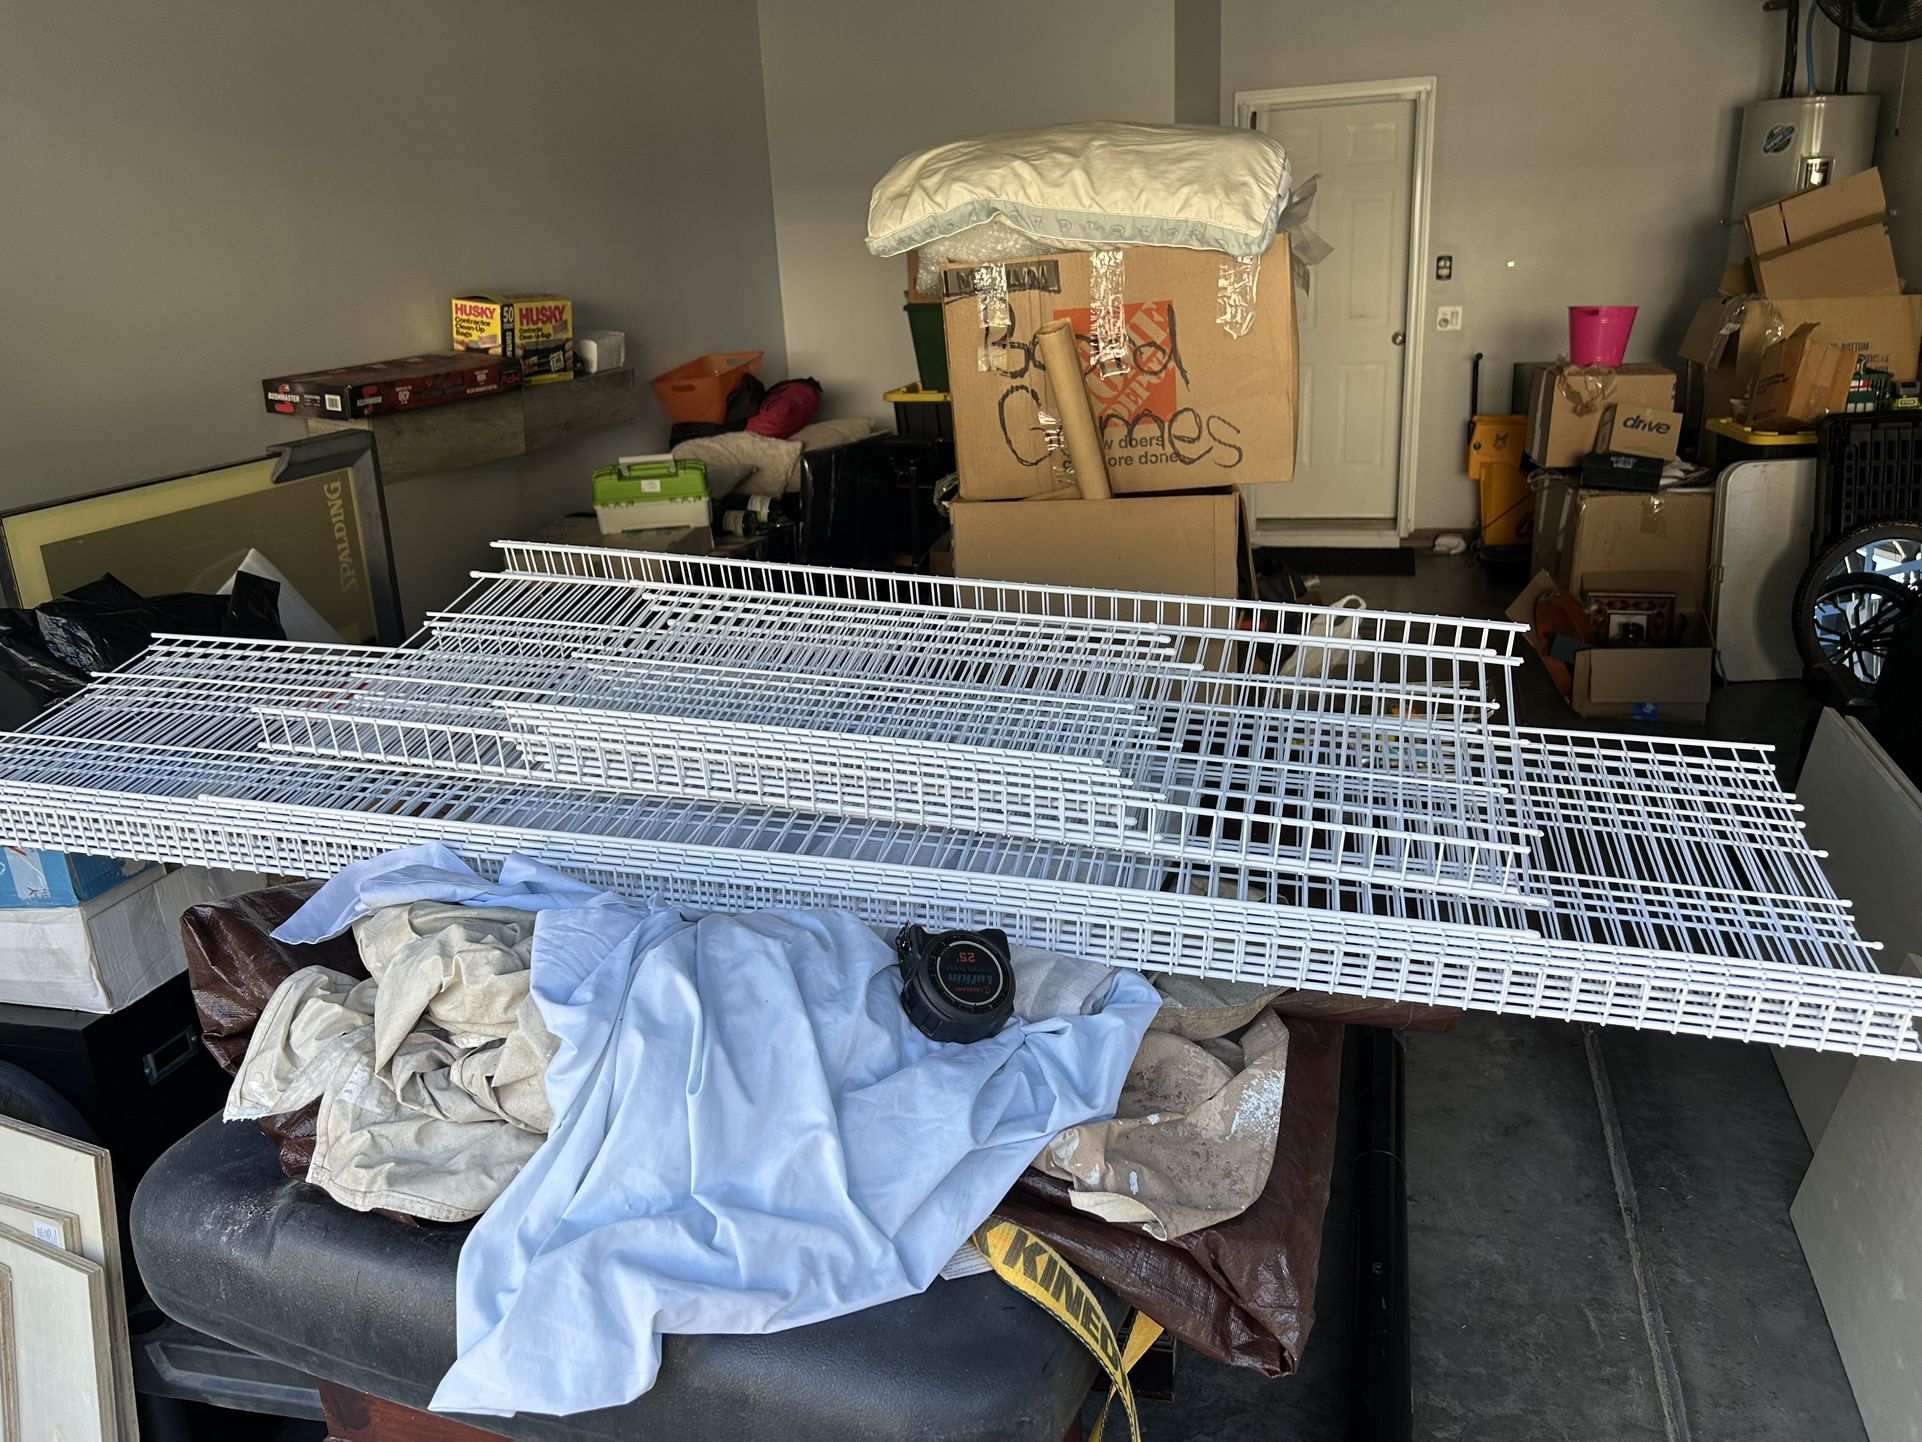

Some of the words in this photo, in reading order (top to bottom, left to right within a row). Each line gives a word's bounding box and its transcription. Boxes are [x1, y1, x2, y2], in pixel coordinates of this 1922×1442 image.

[455, 303, 496, 320] HUSKY
[503, 306, 514, 323] 50
[519, 305, 566, 327] HUSKY
[454, 316, 491, 327] Contractor
[455, 328, 473, 339] Bags
[1106, 348, 1173, 424] DEPOT
[267, 391, 300, 403] BUSHMASTER
[998, 384, 1243, 468] Gmes
[1622, 414, 1670, 435] drive
[1119, 433, 1165, 450] doers
[1108, 452, 1133, 467] ore
[323, 480, 359, 593] SPALDING
[948, 973, 993, 985] Lufkin
